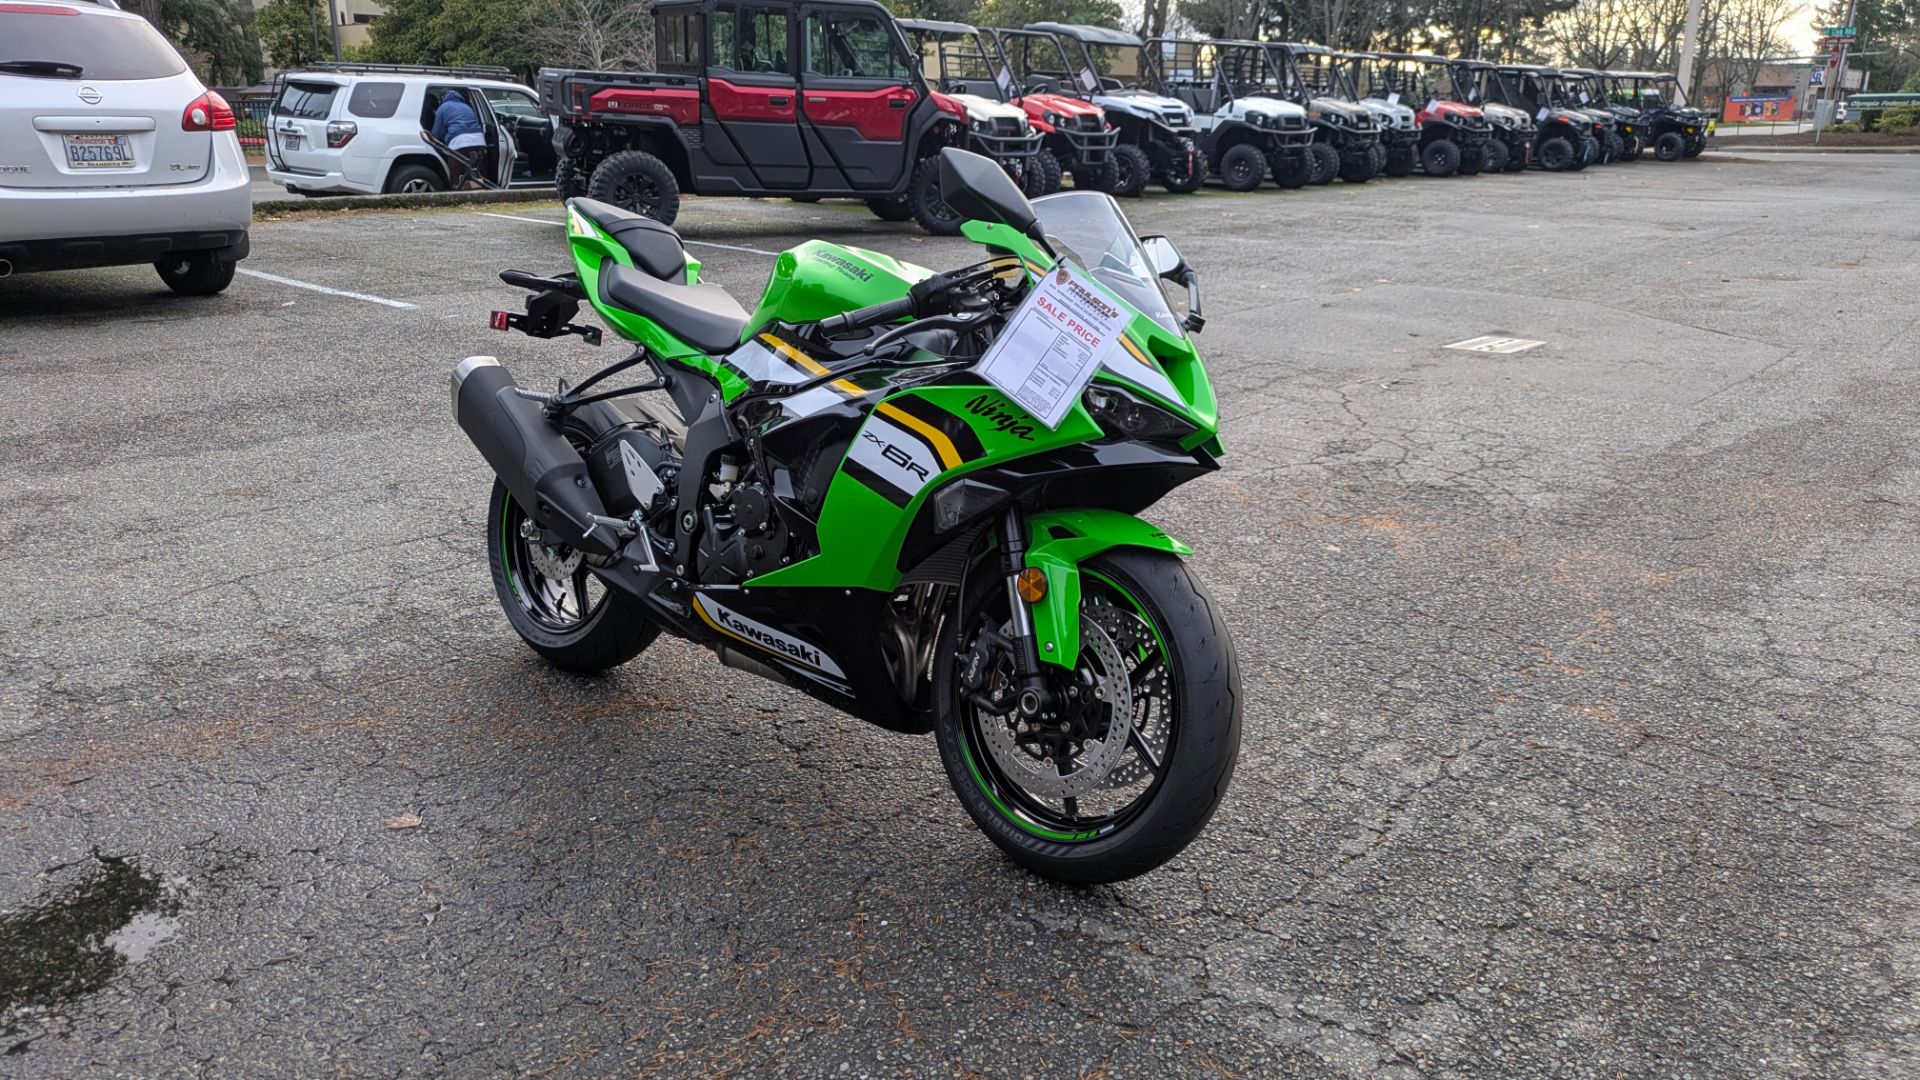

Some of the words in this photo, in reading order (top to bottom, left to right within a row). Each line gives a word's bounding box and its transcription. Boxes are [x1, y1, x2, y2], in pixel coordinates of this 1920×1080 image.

[812, 249, 874, 282] Kawasaki
[835, 266, 856, 281] Team
[1037, 296, 1068, 322] SALE
[1066, 318, 1101, 348] PRICE
[963, 394, 1035, 442] Ninja
[717, 607, 822, 667] Kawasaki
[977, 801, 1025, 845] DIABLO
